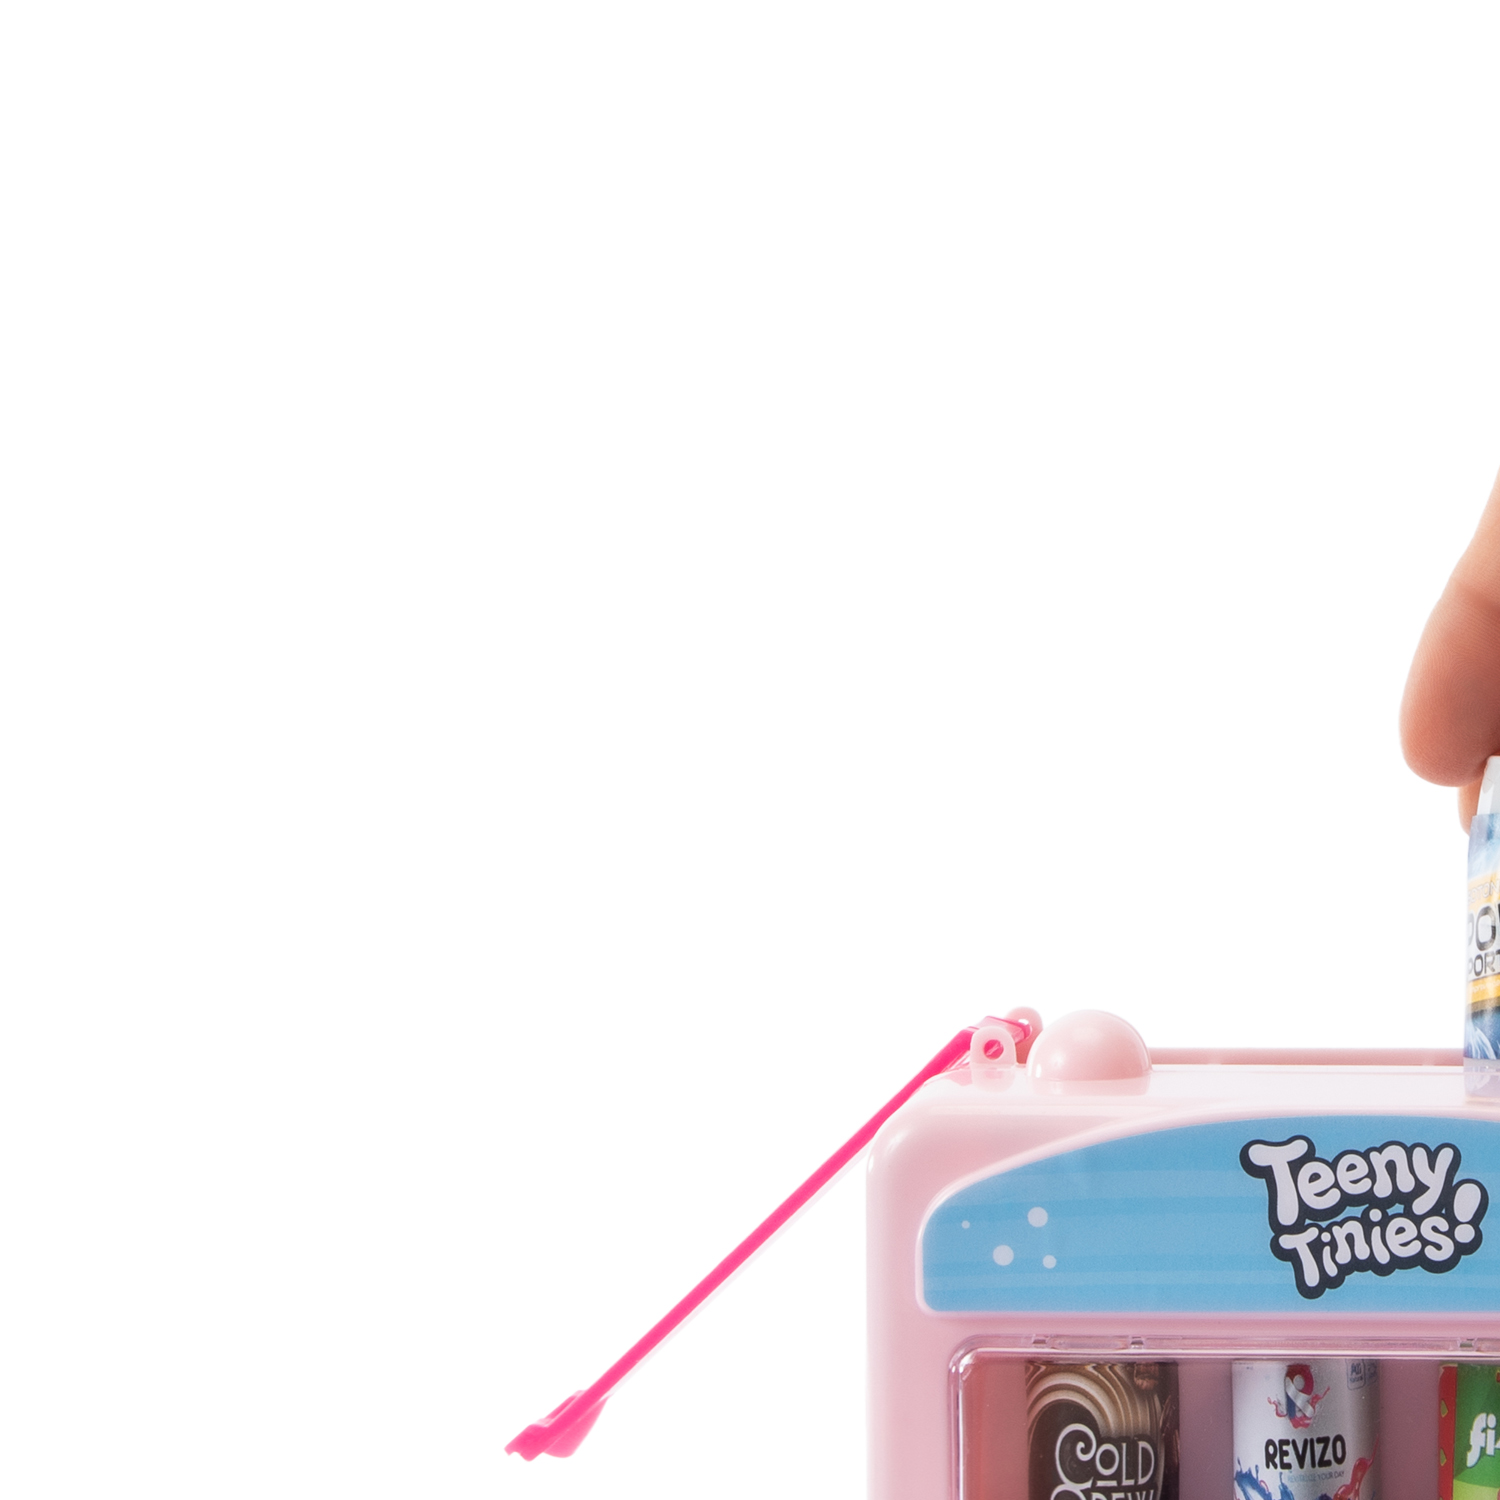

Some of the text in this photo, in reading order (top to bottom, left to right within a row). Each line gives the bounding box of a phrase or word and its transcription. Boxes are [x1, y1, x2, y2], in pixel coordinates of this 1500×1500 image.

[1246, 1137, 1456, 1229] Teeny
[1277, 1182, 1483, 1288] Tinies!
[1055, 1423, 1155, 1488] COLD
[1264, 1434, 1346, 1470] REVIZO
